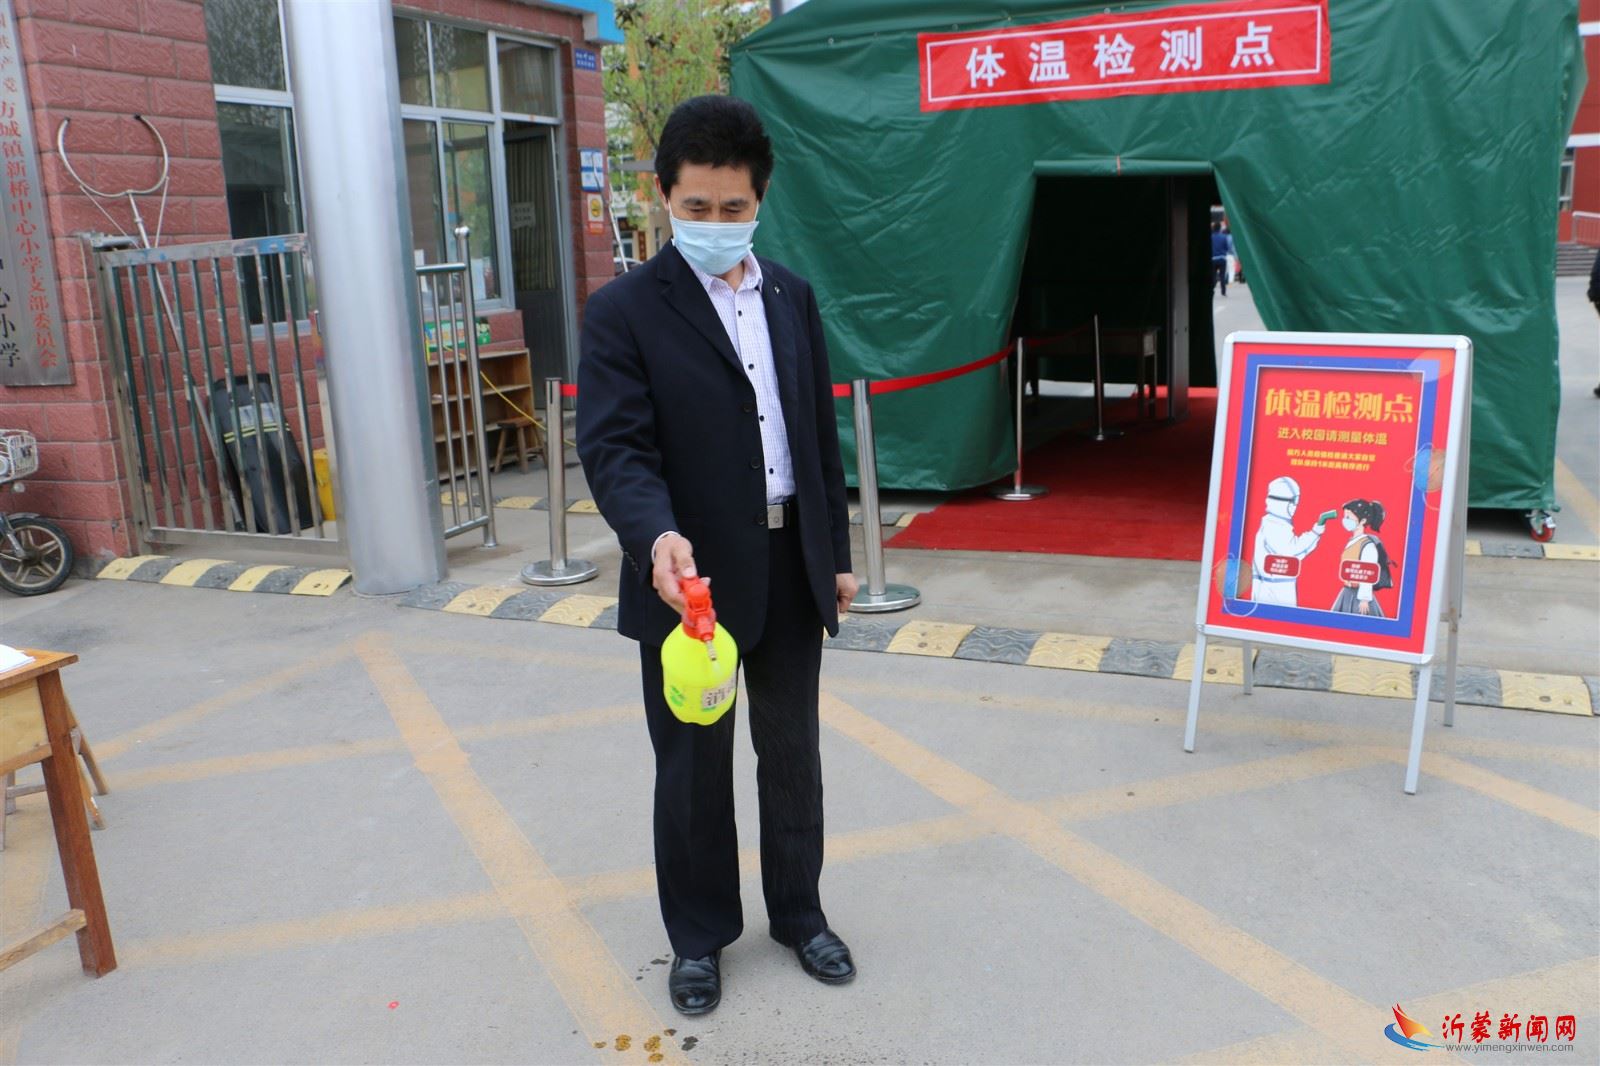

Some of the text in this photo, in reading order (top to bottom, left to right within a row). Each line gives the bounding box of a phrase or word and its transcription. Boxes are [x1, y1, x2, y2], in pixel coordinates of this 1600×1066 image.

[965, 21, 1274, 89] 体温检测点
[1264, 388, 1414, 424] 体温检测点
[1277, 427, 1388, 446] 进入校园请测量体温
